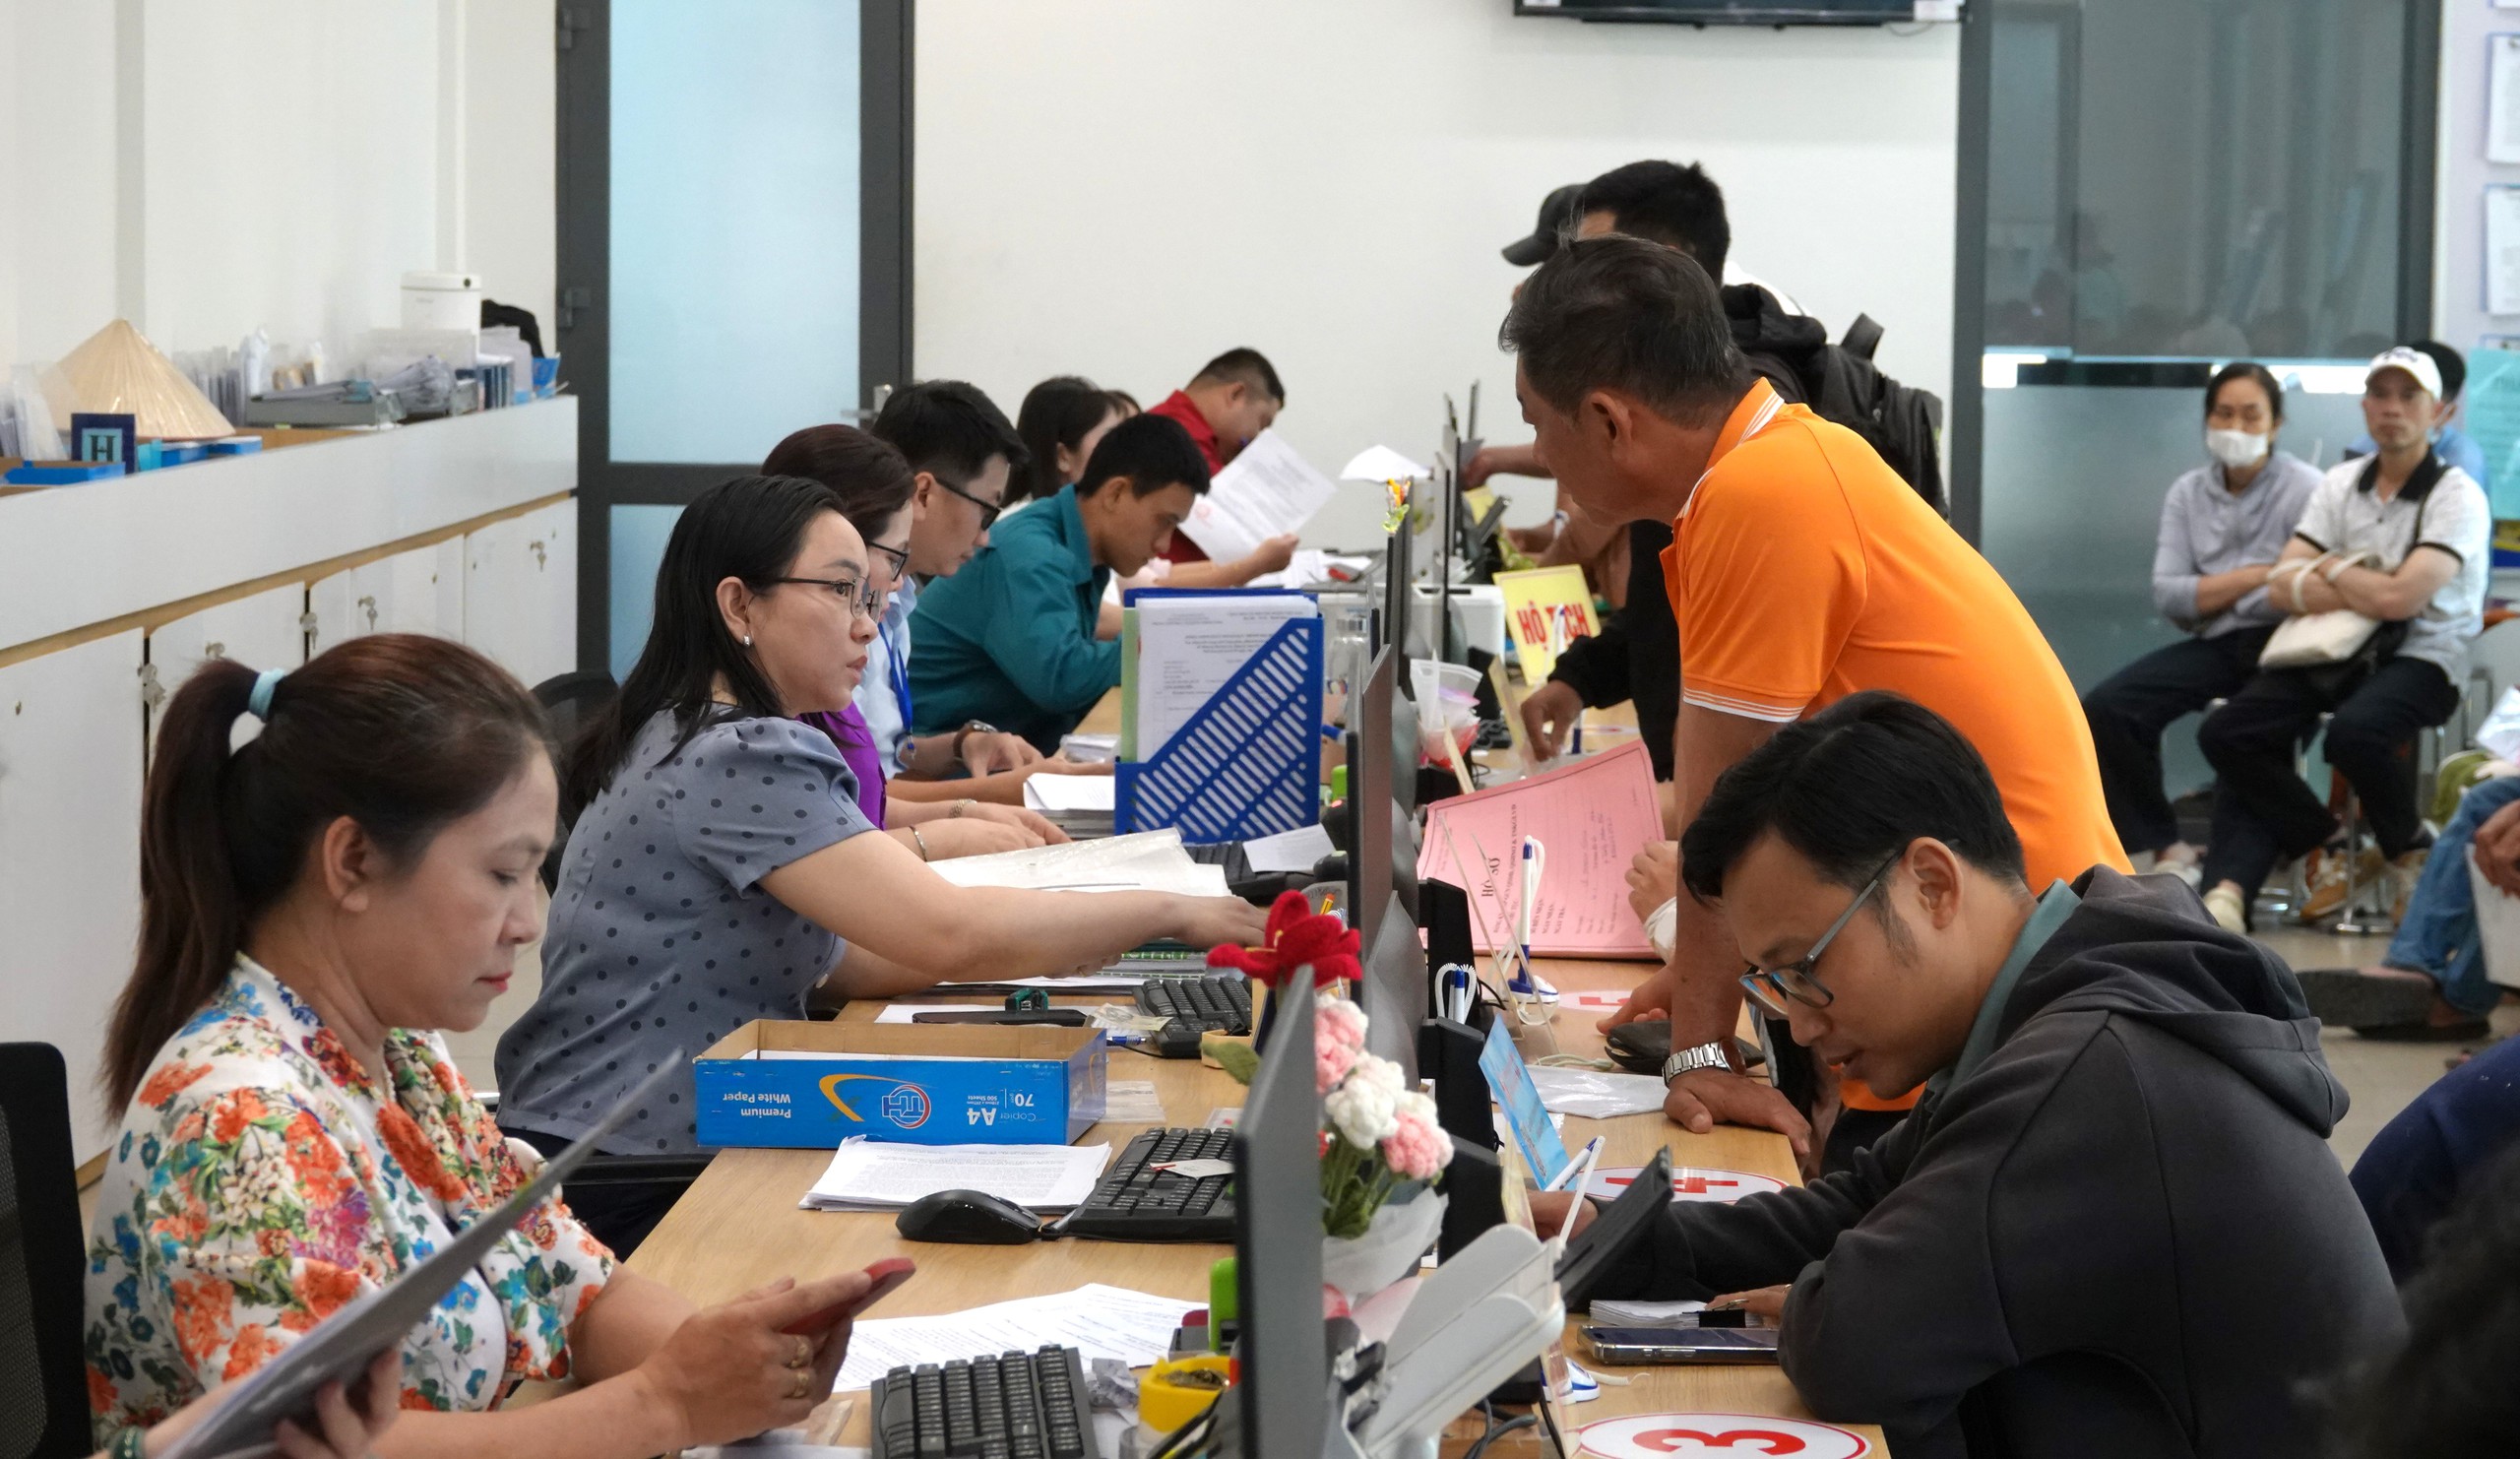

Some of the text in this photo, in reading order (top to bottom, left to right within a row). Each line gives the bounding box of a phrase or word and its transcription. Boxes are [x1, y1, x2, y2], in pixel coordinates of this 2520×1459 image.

[1544, 603, 1592, 645] TCH
[723, 1092, 790, 1104] White Paper
[1015, 1093, 1035, 1107] 70
[740, 1109, 791, 1118] Premium
[967, 1108, 1037, 1126] Copier A4
[1632, 1428, 1806, 1456] 3
